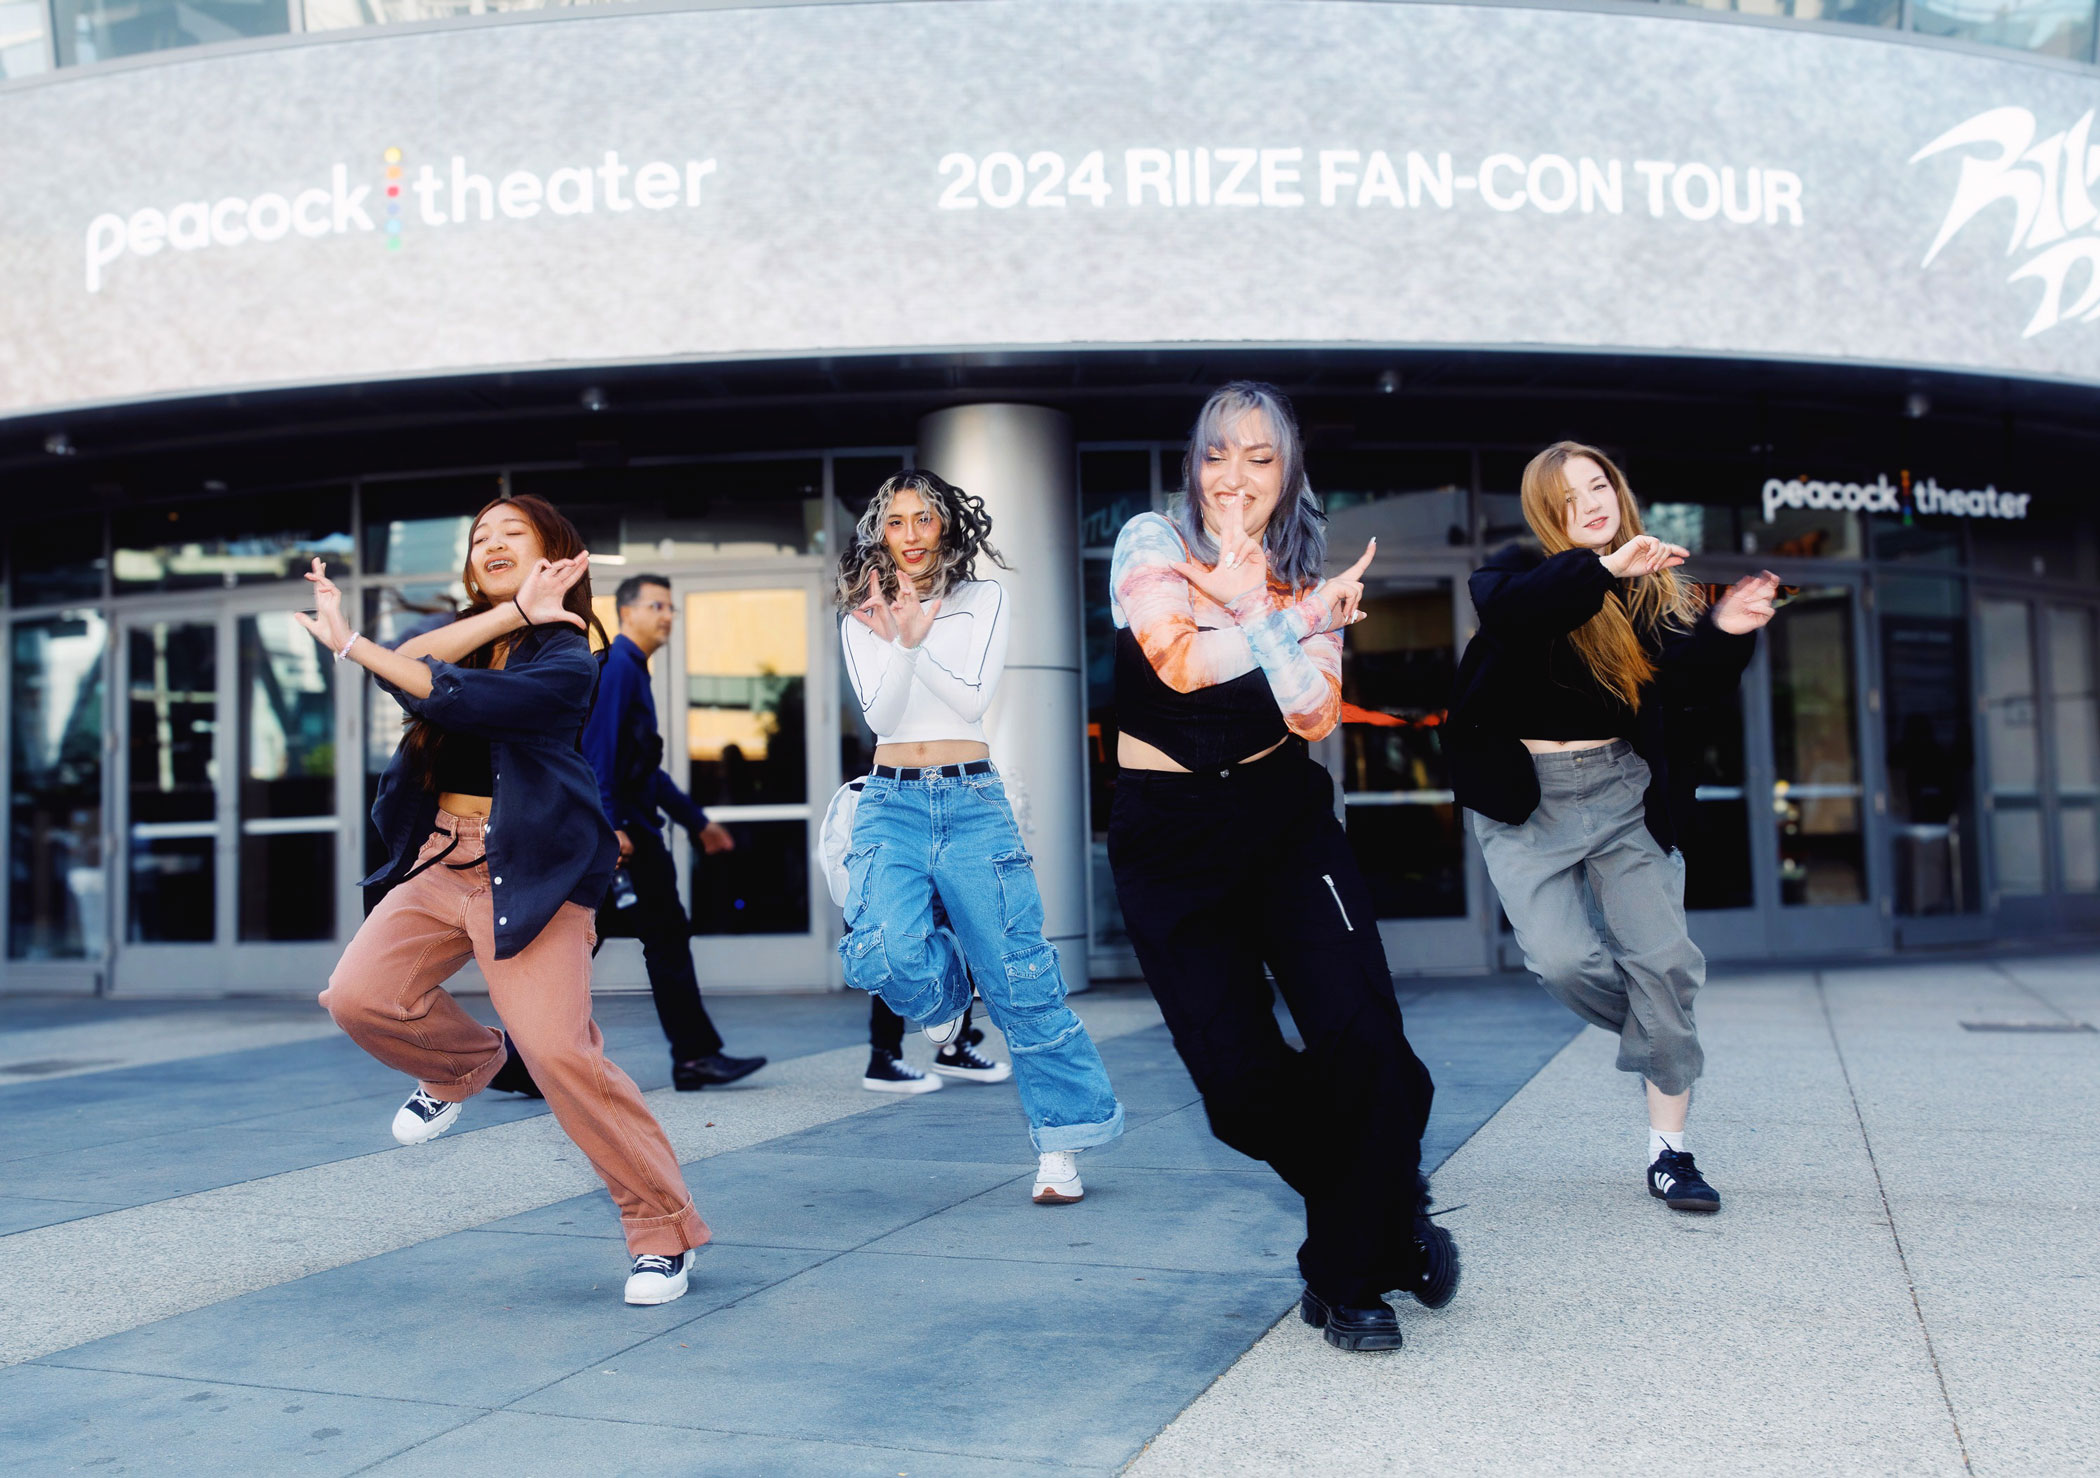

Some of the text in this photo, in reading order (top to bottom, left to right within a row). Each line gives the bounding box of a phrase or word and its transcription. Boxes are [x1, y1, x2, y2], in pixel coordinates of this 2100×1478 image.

[86, 150, 717, 293] peacock theater
[937, 147, 1804, 227] 2024 RIIZE FAN-CON TOUR
[1762, 473, 2031, 525] peacock theater
